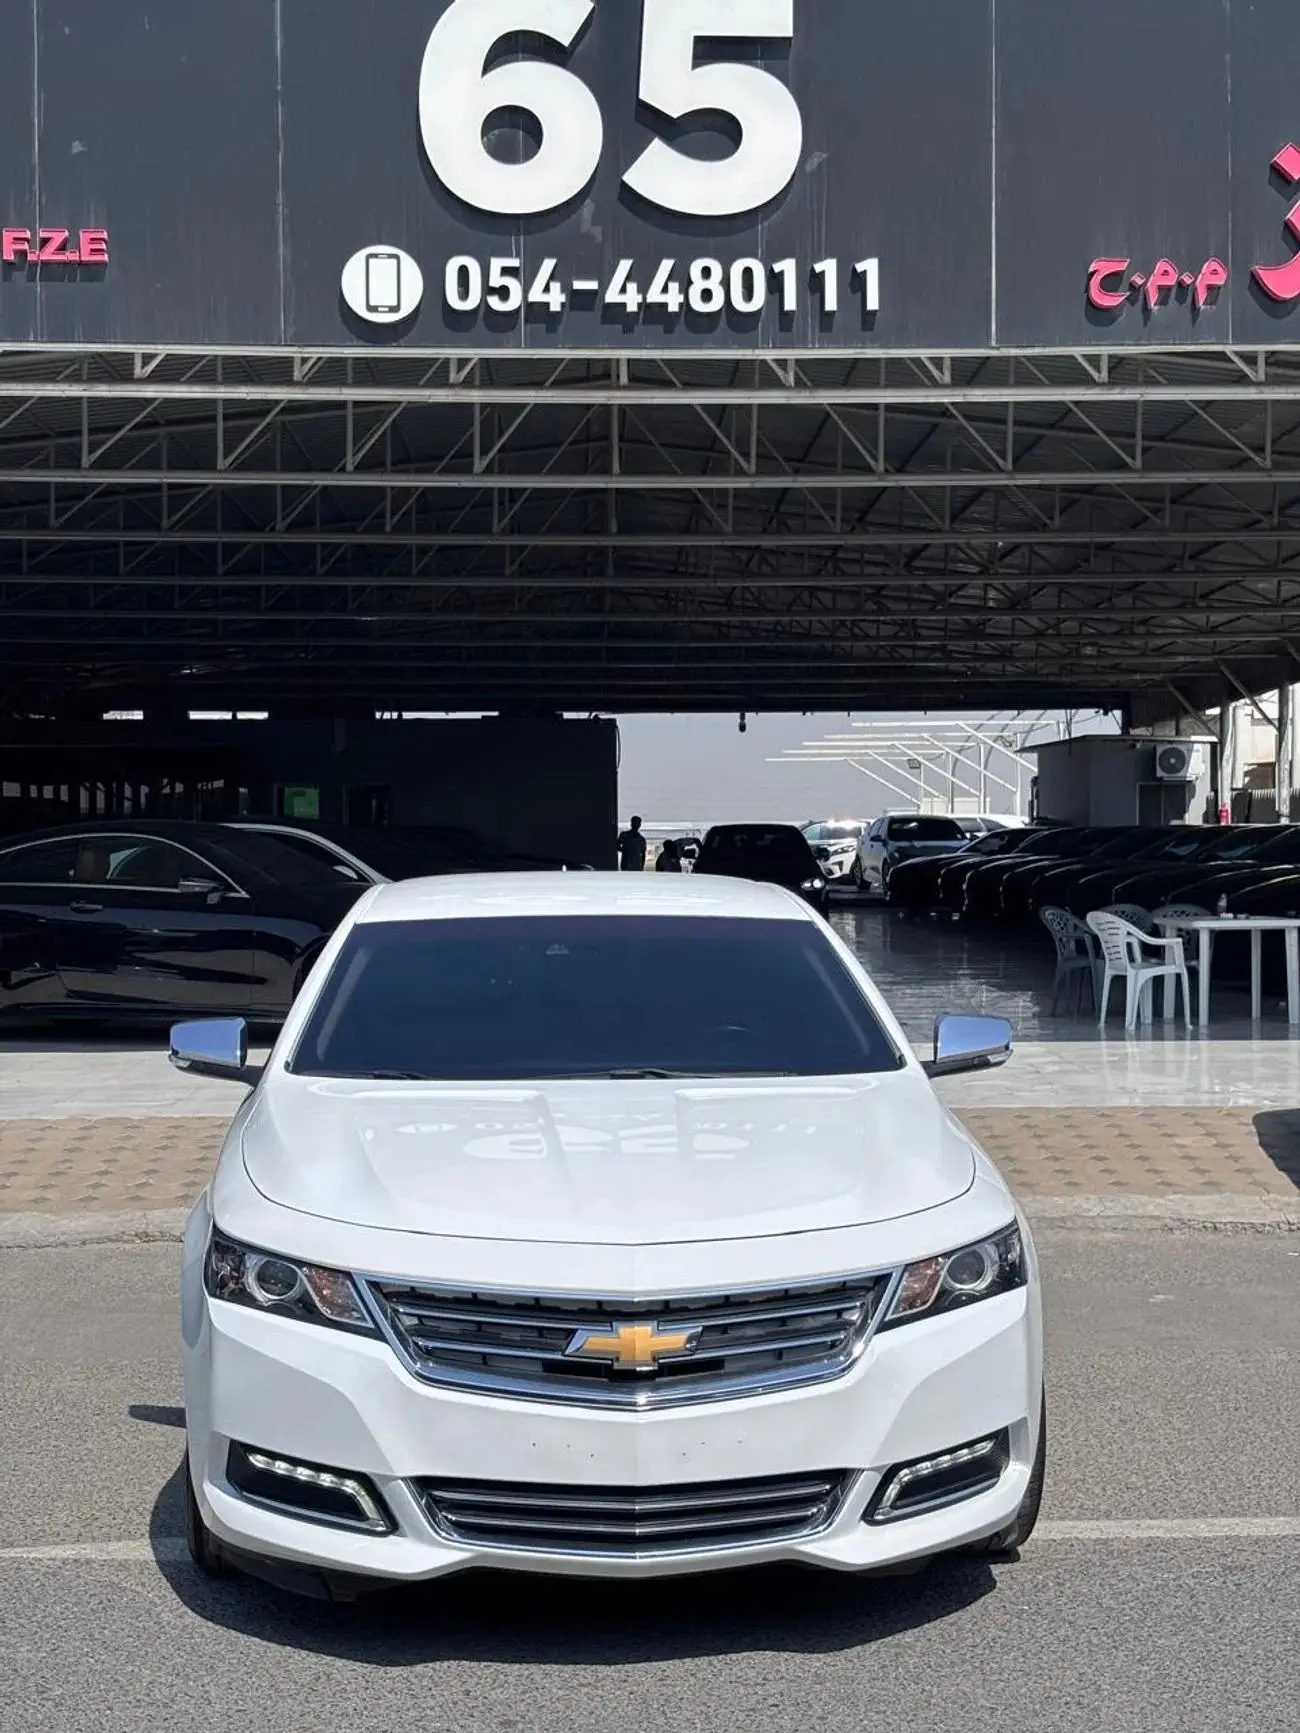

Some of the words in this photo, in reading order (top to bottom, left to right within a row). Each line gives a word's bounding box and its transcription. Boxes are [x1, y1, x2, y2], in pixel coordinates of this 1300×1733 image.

[418, 0, 803, 216] 65
[2, 228, 109, 264] F.Z.E
[444, 256, 880, 314] 054-4480111
